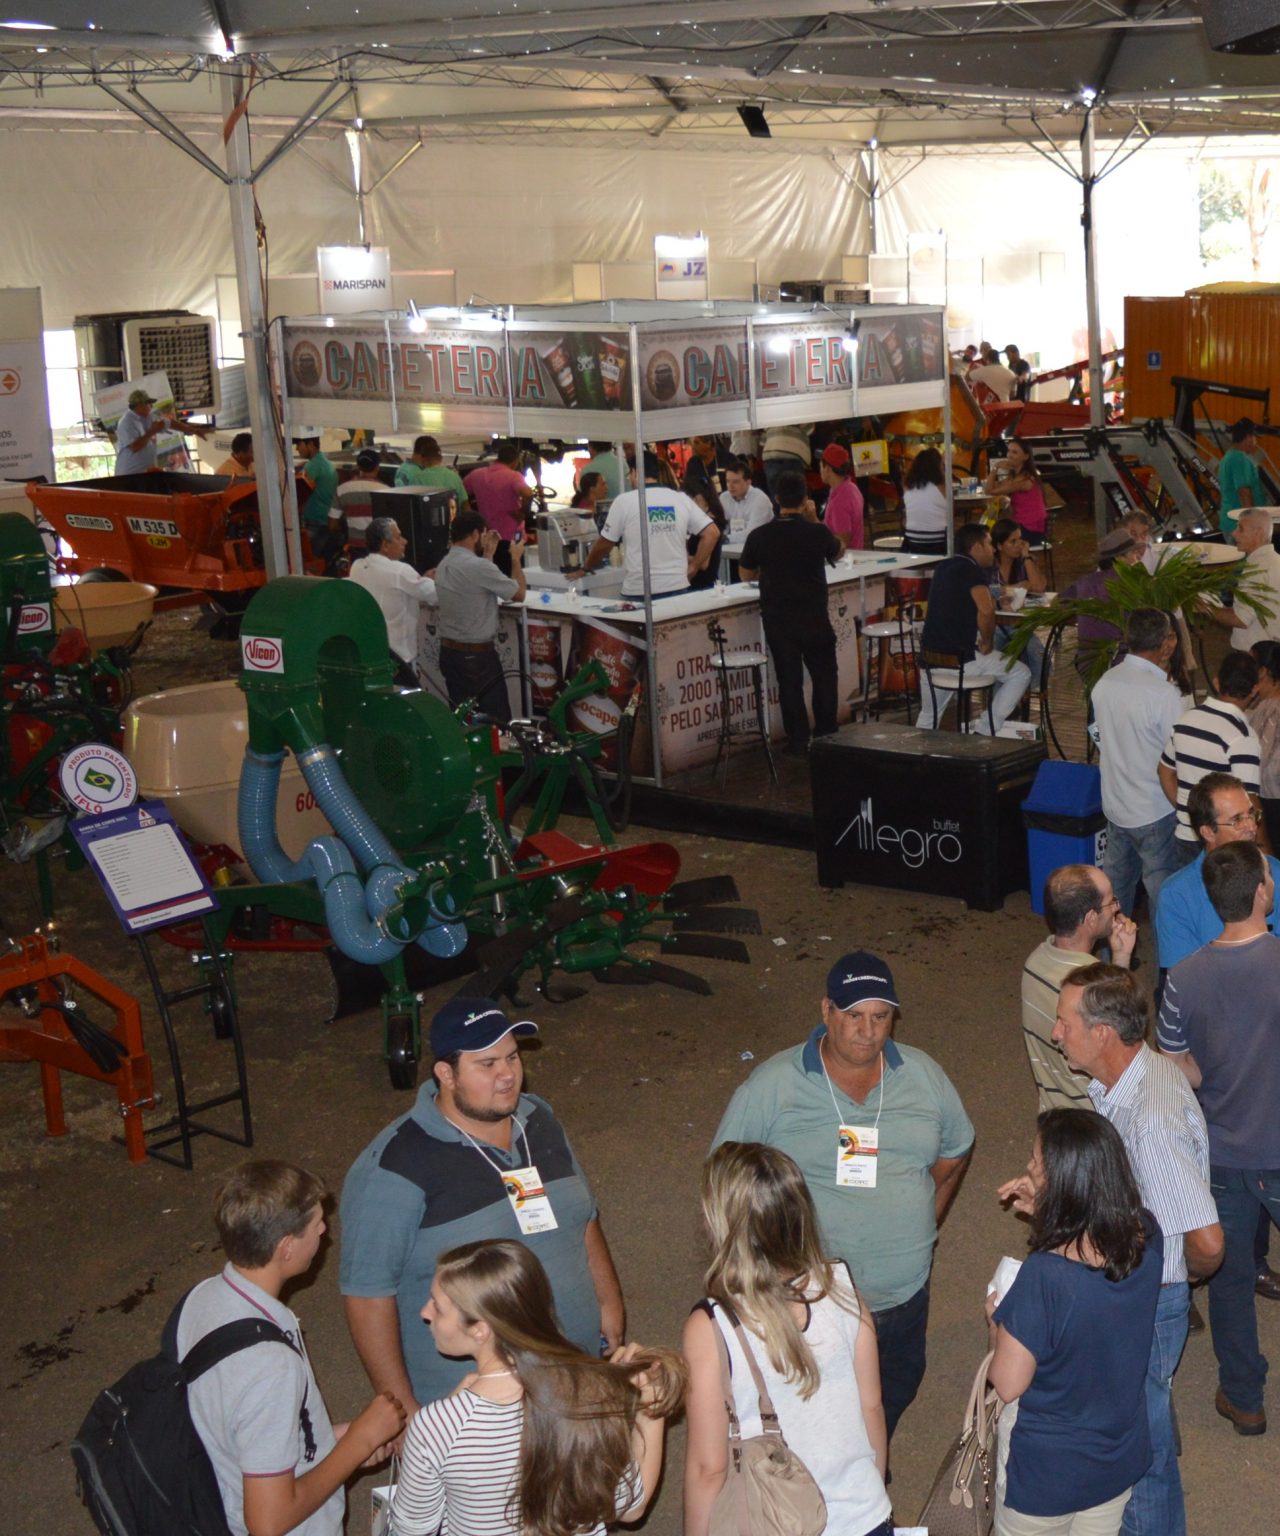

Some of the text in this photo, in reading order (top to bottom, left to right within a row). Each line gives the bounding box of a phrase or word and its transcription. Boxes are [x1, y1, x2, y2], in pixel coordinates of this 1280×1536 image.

[682, 261, 705, 276] JZ
[333, 279, 386, 290] MARISPAN
[683, 333, 883, 399] CAFETERA
[130, 519, 142, 531] M
[144, 520, 166, 535] 535
[21, 612, 44, 625] icon
[249, 640, 276, 661] Vicon
[594, 648, 616, 666] Café
[676, 660, 686, 680] O
[679, 679, 712, 705] 2000
[670, 706, 702, 733] PELO
[68, 749, 133, 799] PRODUTO PATENTEADO
[835, 797, 962, 868] Allegro
[932, 817, 961, 833] buffet
